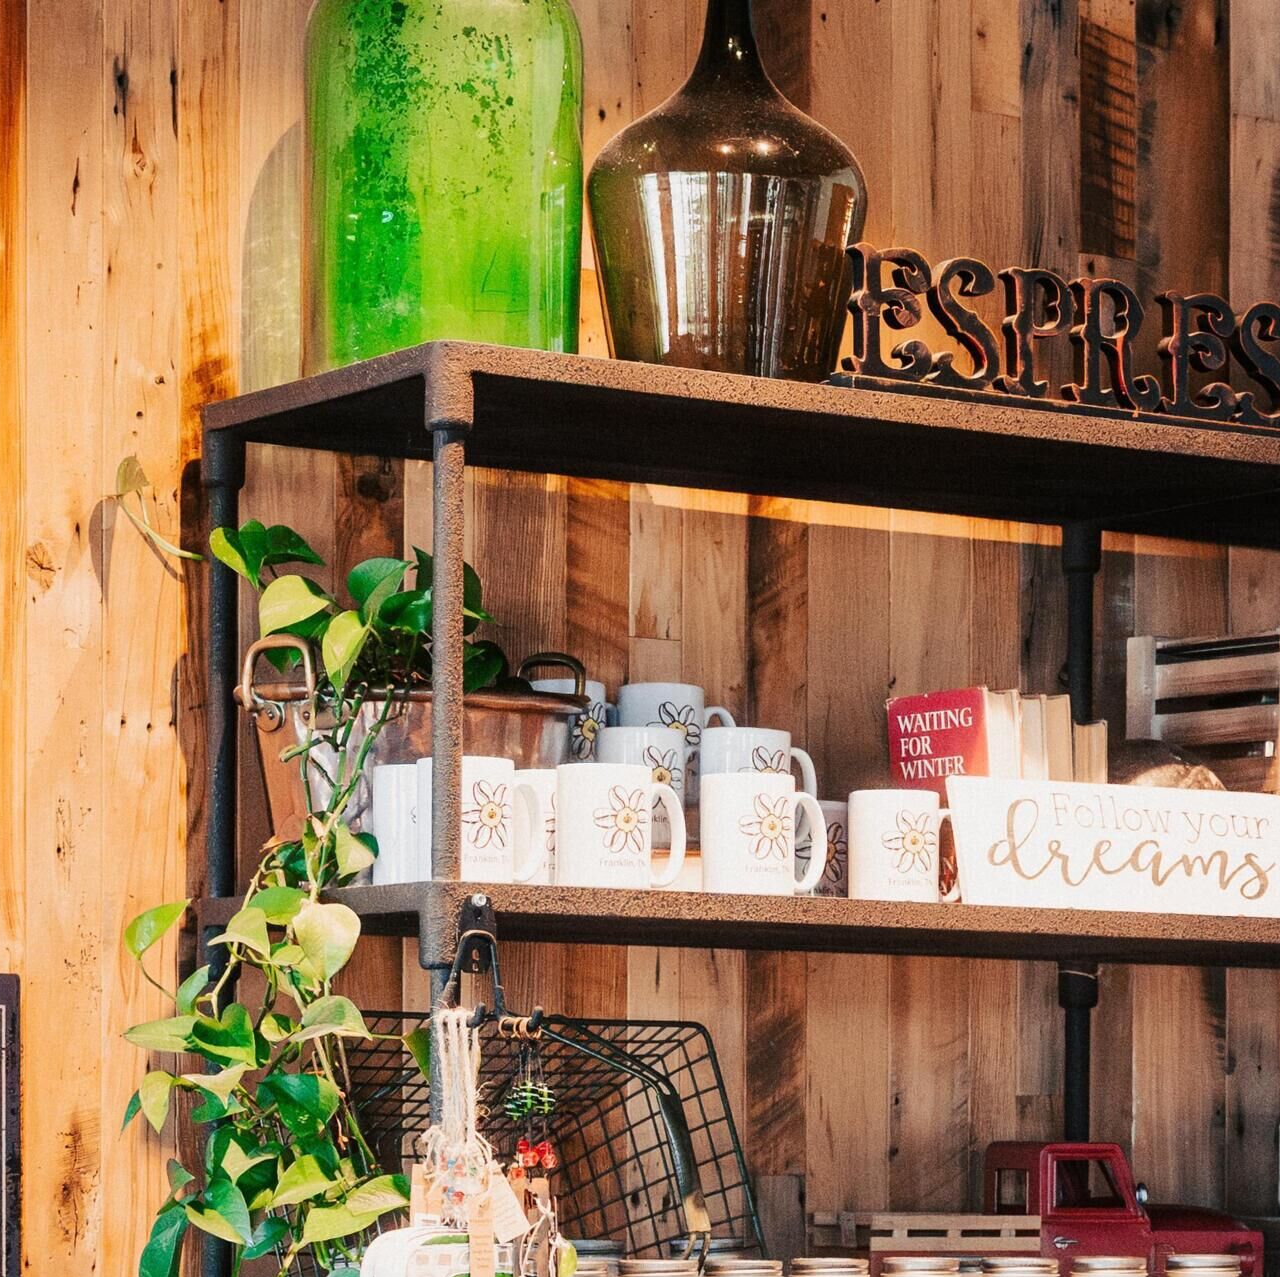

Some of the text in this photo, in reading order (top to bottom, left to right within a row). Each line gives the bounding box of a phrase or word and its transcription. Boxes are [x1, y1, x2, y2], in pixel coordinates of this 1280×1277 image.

[897, 707, 974, 733] WAITING
[899, 738, 933, 758] FOR
[899, 754, 967, 781] WINTER
[1050, 791, 1271, 845] Follow your
[987, 797, 1277, 901] dreams
